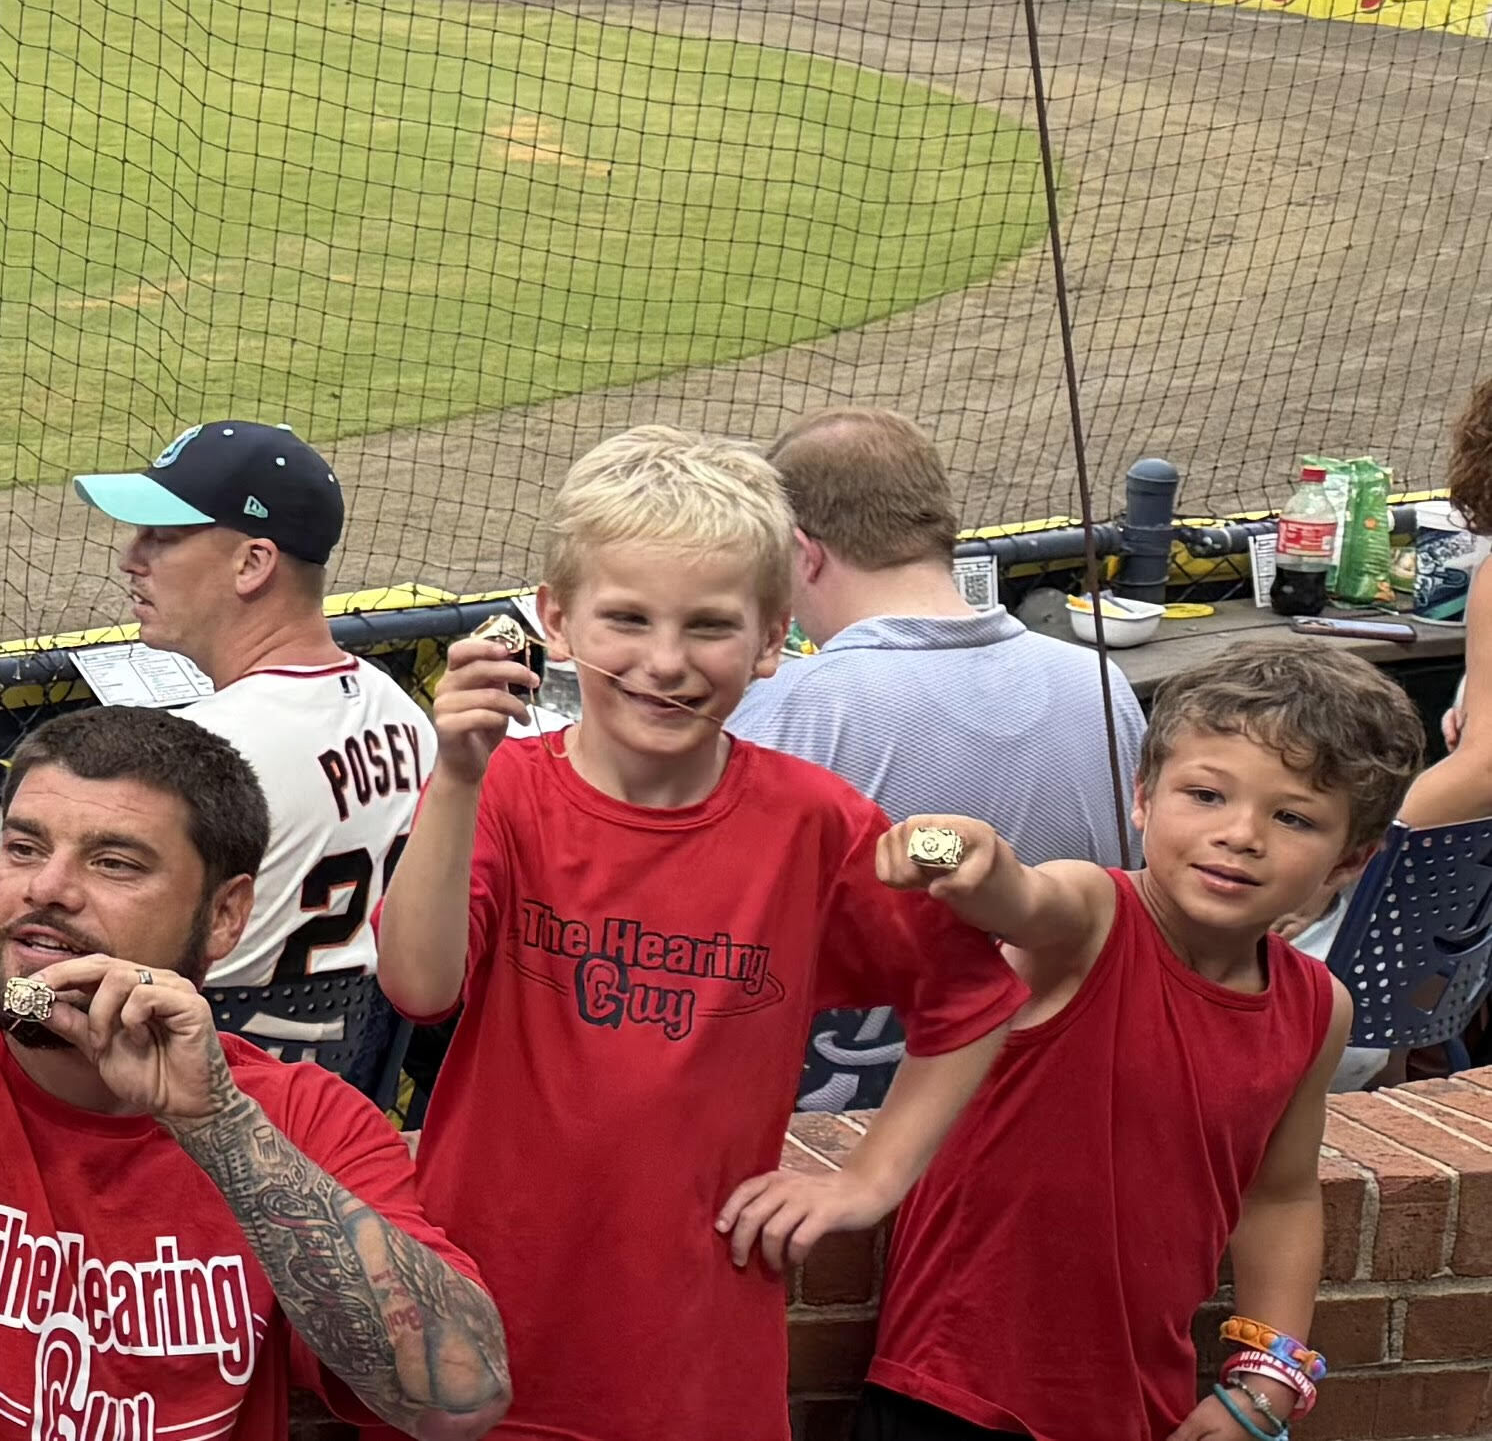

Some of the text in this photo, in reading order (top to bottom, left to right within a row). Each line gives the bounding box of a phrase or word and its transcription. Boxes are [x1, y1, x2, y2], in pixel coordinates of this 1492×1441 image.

[317, 722, 422, 823] POSEY
[521, 897, 771, 996] The Hearing
[574, 951, 695, 1042] Guy
